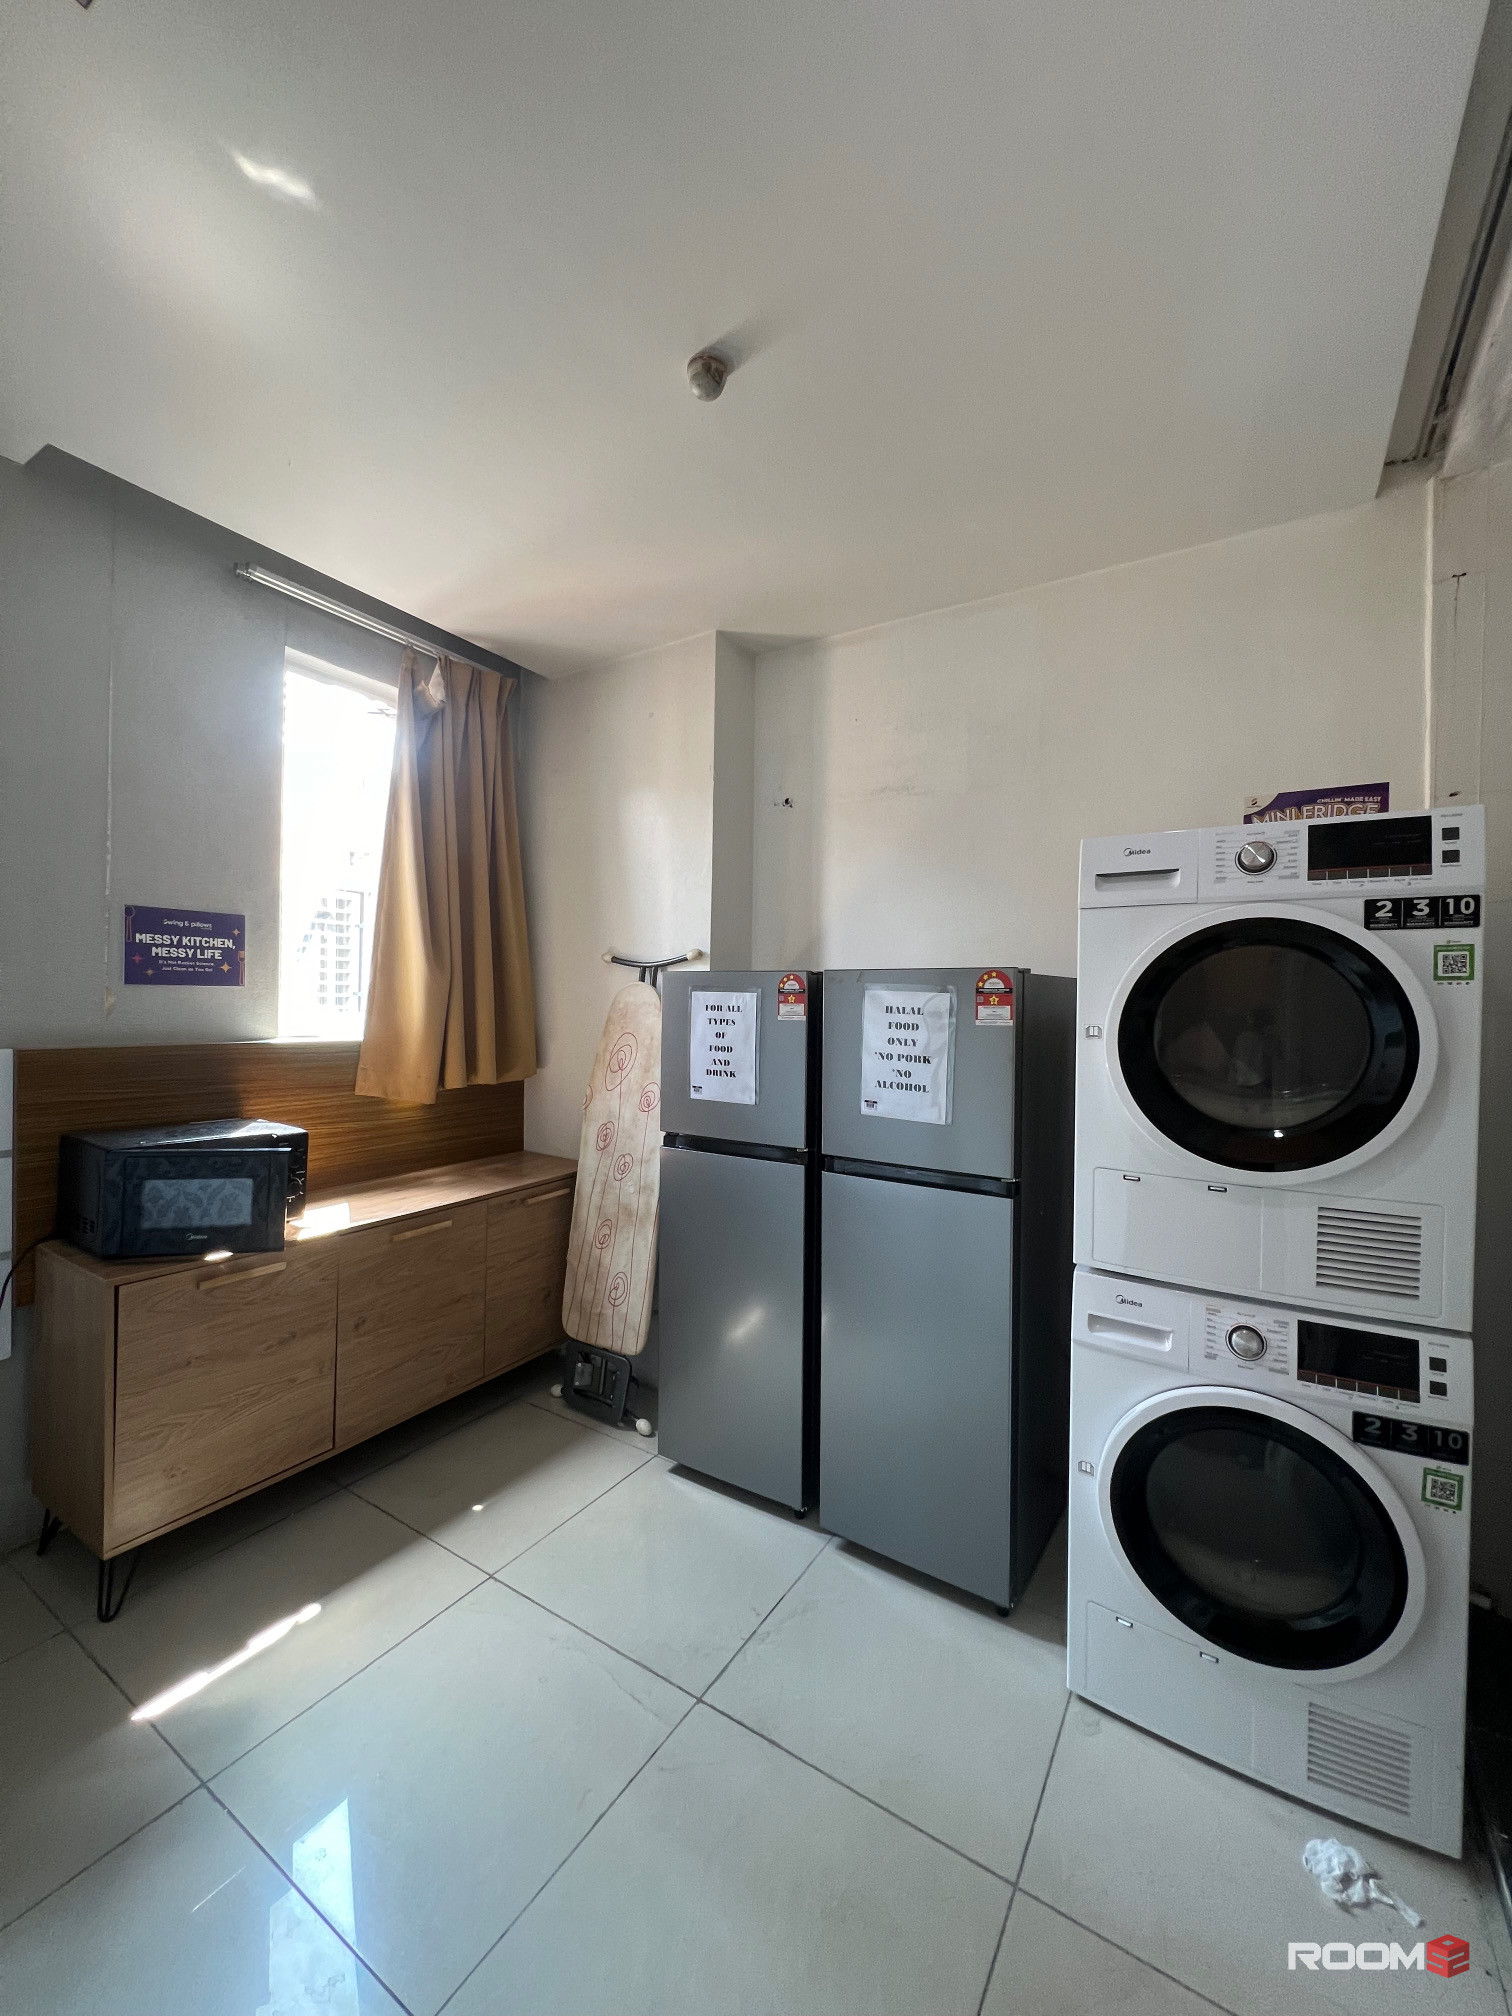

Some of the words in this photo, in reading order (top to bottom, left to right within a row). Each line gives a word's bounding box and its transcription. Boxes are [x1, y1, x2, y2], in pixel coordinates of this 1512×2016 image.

[1301, 802, 1381, 820] FRIDGE
[1123, 847, 1151, 857] Midea
[1374, 900, 1393, 918] 2
[1411, 898, 1430, 917] 3
[1445, 896, 1476, 915] 10
[135, 932, 180, 945] MESSY
[182, 935, 236, 950] KITCHEN,
[151, 946, 195, 958] MESSY
[196, 948, 222, 960] LIFE
[705, 1004, 723, 1012] FOR
[725, 1004, 743, 1013] ALL
[885, 1005, 924, 1016] HALAL
[707, 1017, 736, 1026] TYPES
[888, 1021, 920, 1032] FOOD
[714, 1031, 727, 1039] OF
[887, 1037, 919, 1047] ONLY
[708, 1044, 733, 1054] FOOD
[710, 1058, 731, 1067] AND
[897, 1054, 932, 1065] PORK
[705, 1068, 737, 1078] DRINK
[874, 1079, 930, 1094] ALCOHOL
[1115, 1294, 1143, 1308] Midea
[1364, 1416, 1382, 1435] 2
[1401, 1423, 1418, 1442] 3
[1433, 1429, 1463, 1450] 10
